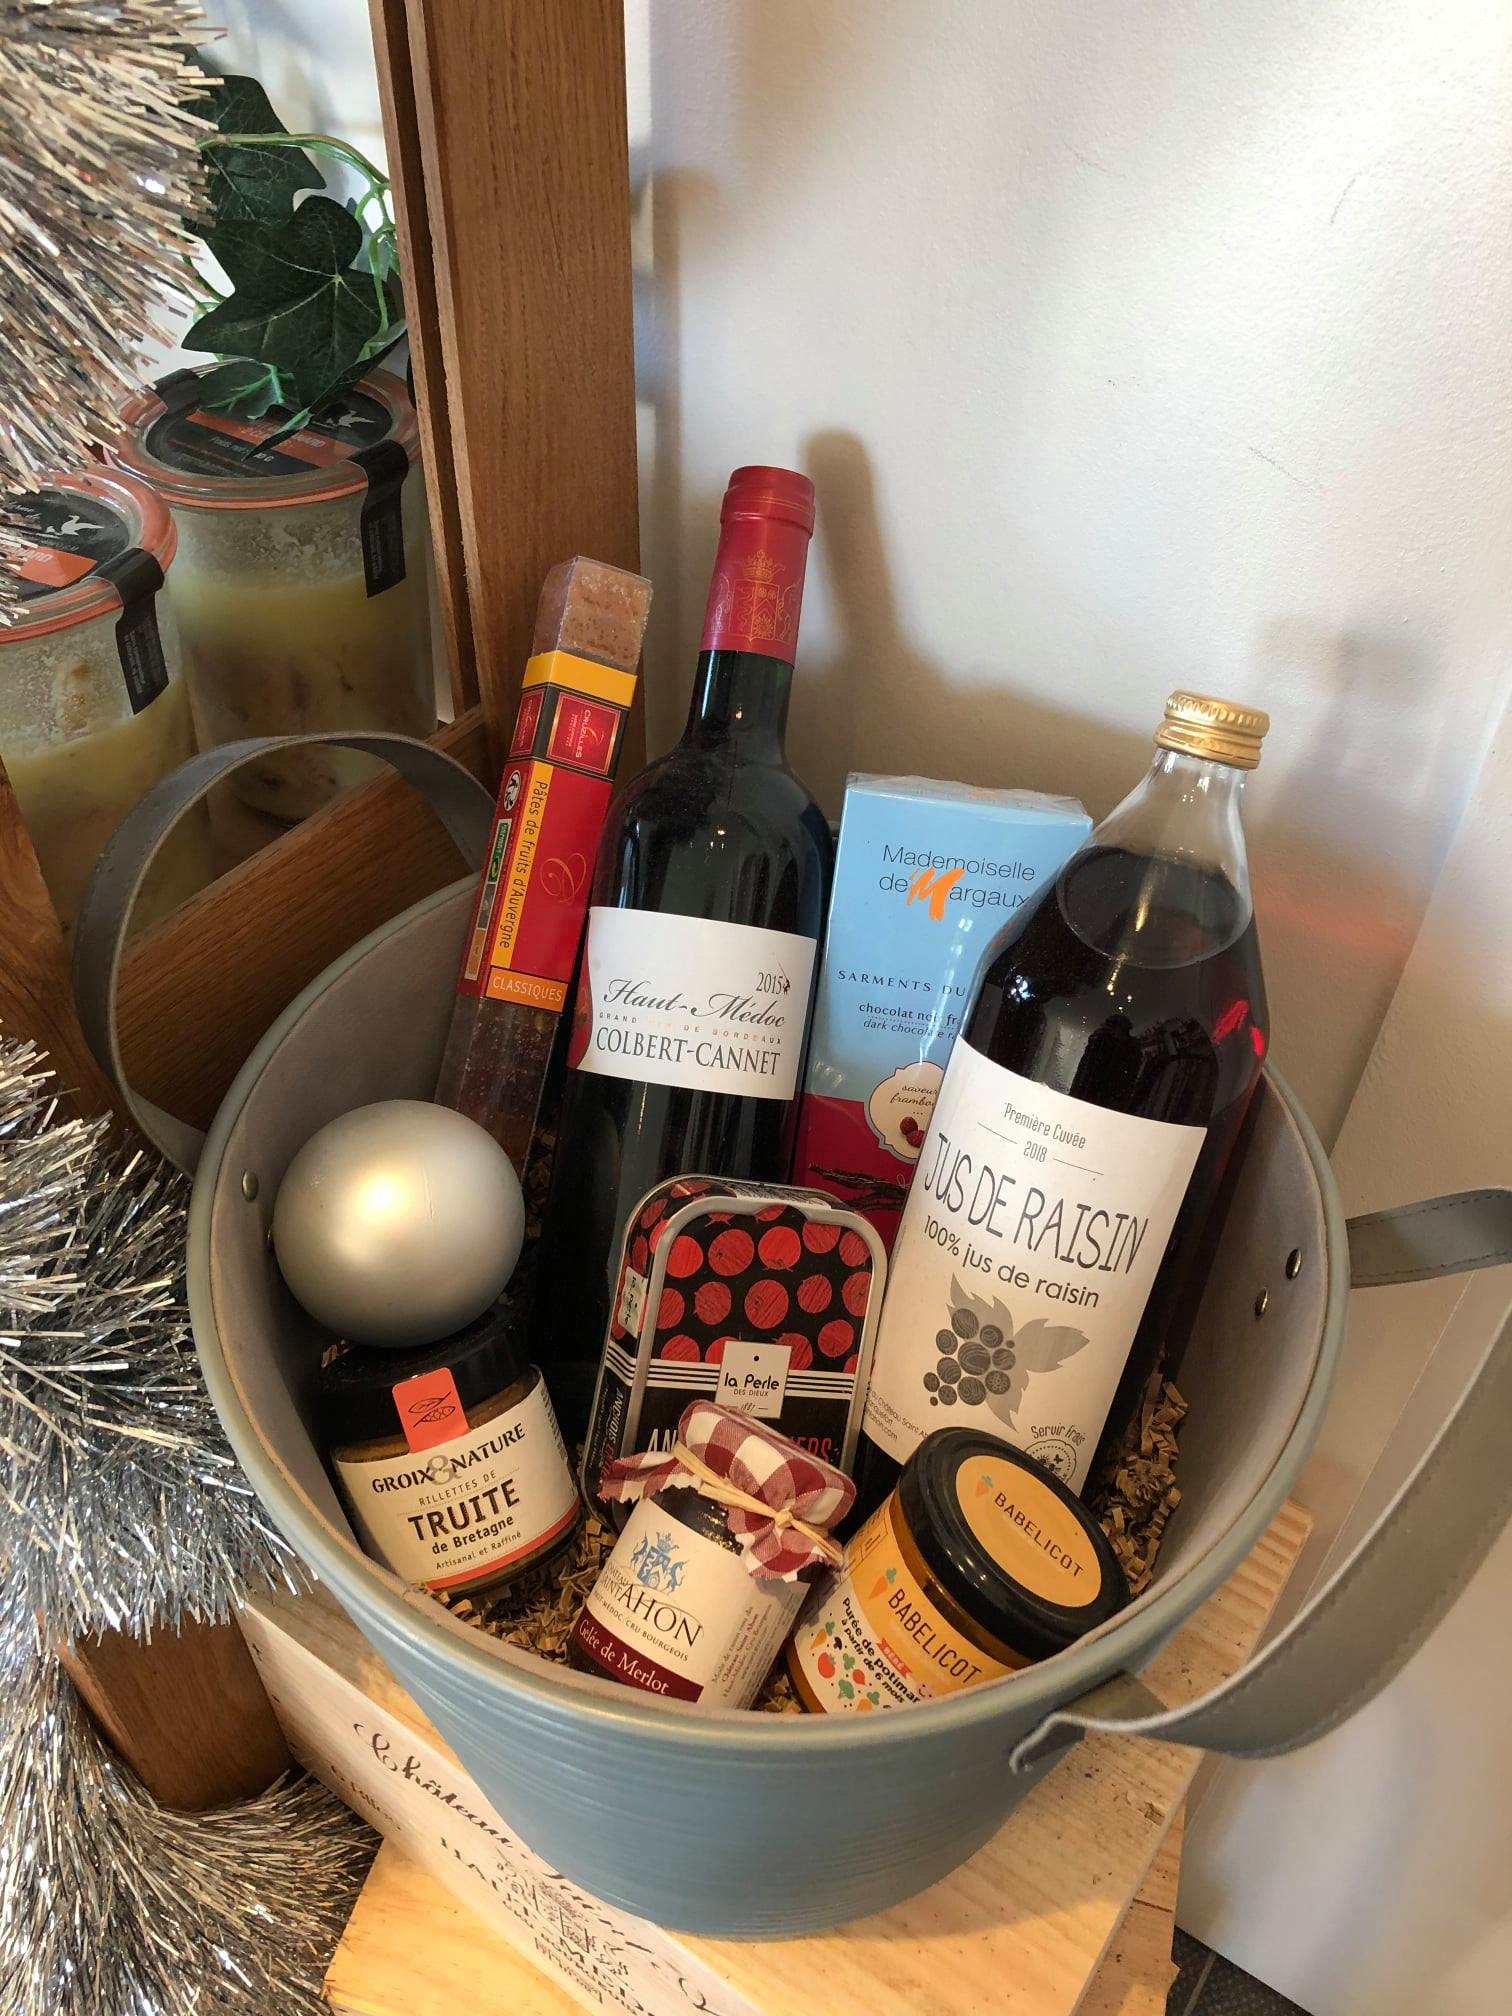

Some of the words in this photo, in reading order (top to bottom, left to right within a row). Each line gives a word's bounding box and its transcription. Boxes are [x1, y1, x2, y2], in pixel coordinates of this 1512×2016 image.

[572, 709, 591, 759] CRUZILLES
[528, 781, 549, 813] Pâtes
[526, 816, 540, 836] de
[519, 838, 537, 874] fruits
[883, 845, 1035, 881] Mademoiselle
[500, 877, 526, 949] d'Auvergne
[492, 975, 563, 1002] CLASSIQUES
[756, 972, 783, 994] 2015
[838, 970, 931, 992] SARMENTS
[604, 979, 785, 1028] Haut-Médoc
[859, 1001, 913, 1020] chocolat
[863, 1018, 888, 1032] dark
[599, 1012, 639, 1024] GRAND
[713, 1028, 782, 1044] BORDEAUX
[596, 1027, 780, 1076] COLBERT-CANNET
[1003, 1103, 1051, 1137] Première
[1053, 1125, 1087, 1150] Cuvée
[1023, 1141, 1048, 1163] 2018
[924, 1132, 972, 1214] JUS
[967, 1165, 1016, 1239] DE
[1013, 1187, 1149, 1274] RAISIN
[924, 1214, 960, 1257] 100%
[962, 1243, 993, 1273] jus
[997, 1263, 1030, 1290] de
[1035, 1277, 1100, 1309] raisin
[724, 1372, 737, 1387] la
[744, 1374, 779, 1390] Perle
[607, 1387, 623, 1443] ANCHOIS
[1031, 1422, 1065, 1439] Servir
[1065, 1425, 1085, 1446] frais
[372, 1467, 435, 1494] GROIX
[428, 1455, 463, 1486] &
[450, 1422, 526, 1473] NATURE
[419, 1479, 478, 1506] RILLETTES
[483, 1469, 497, 1482] DE
[408, 1478, 521, 1541] TRUITE
[432, 1541, 449, 1555] de
[453, 1515, 514, 1548] Bretagne
[436, 1551, 476, 1570] Artisanal
[479, 1547, 488, 1555] et
[491, 1530, 521, 1550] Raffiné
[994, 1492, 1083, 1578] BABELICOT
[619, 1583, 702, 1648] AHON
[888, 1588, 982, 1684] BABELICOT
[580, 1620, 600, 1649] Gelée
[600, 1642, 616, 1662] de
[617, 1652, 670, 1694] Merlot
[625, 1619, 640, 1633] CRU
[642, 1631, 688, 1662] BOURGEOIS
[842, 1597, 862, 1637] Purée
[862, 1639, 875, 1657] de
[873, 1658, 921, 1704] potimar
[845, 1628, 864, 1656] partir
[863, 1658, 874, 1671] de
[875, 1672, 884, 1681] 6
[882, 1681, 905, 1703] mois
